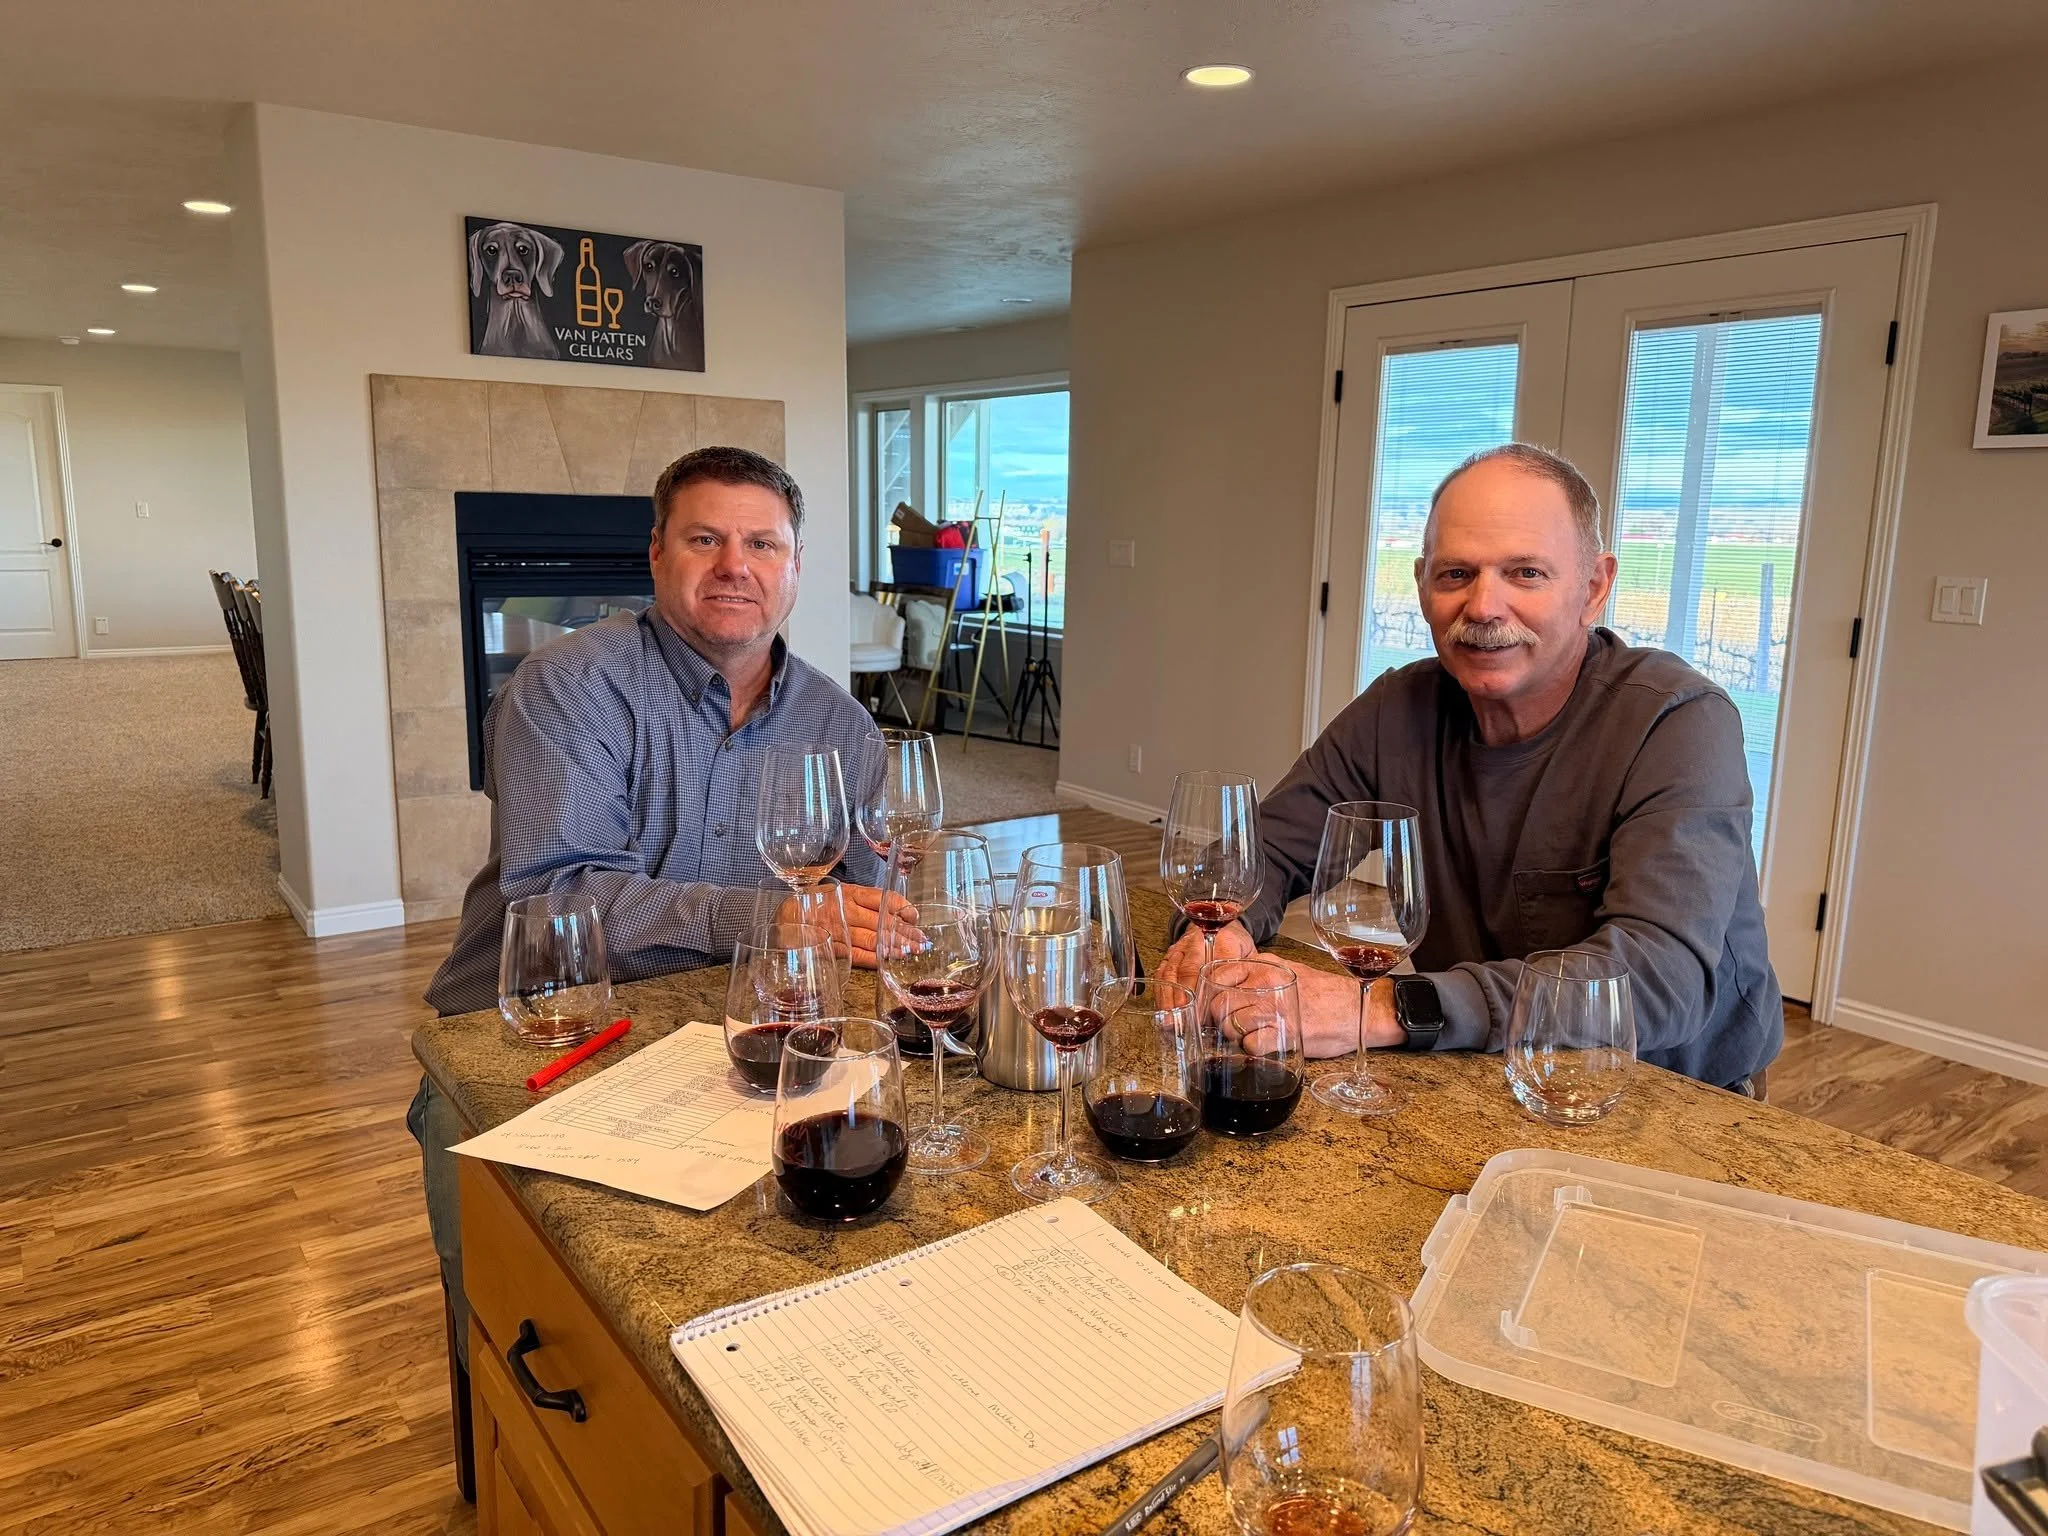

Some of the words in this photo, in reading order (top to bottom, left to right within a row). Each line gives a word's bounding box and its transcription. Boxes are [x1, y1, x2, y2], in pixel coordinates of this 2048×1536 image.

[555, 327, 586, 341] VAN
[591, 330, 646, 346] PATTEN
[569, 343, 634, 360] CELLARS
[1144, 1492, 1165, 1517] Round
